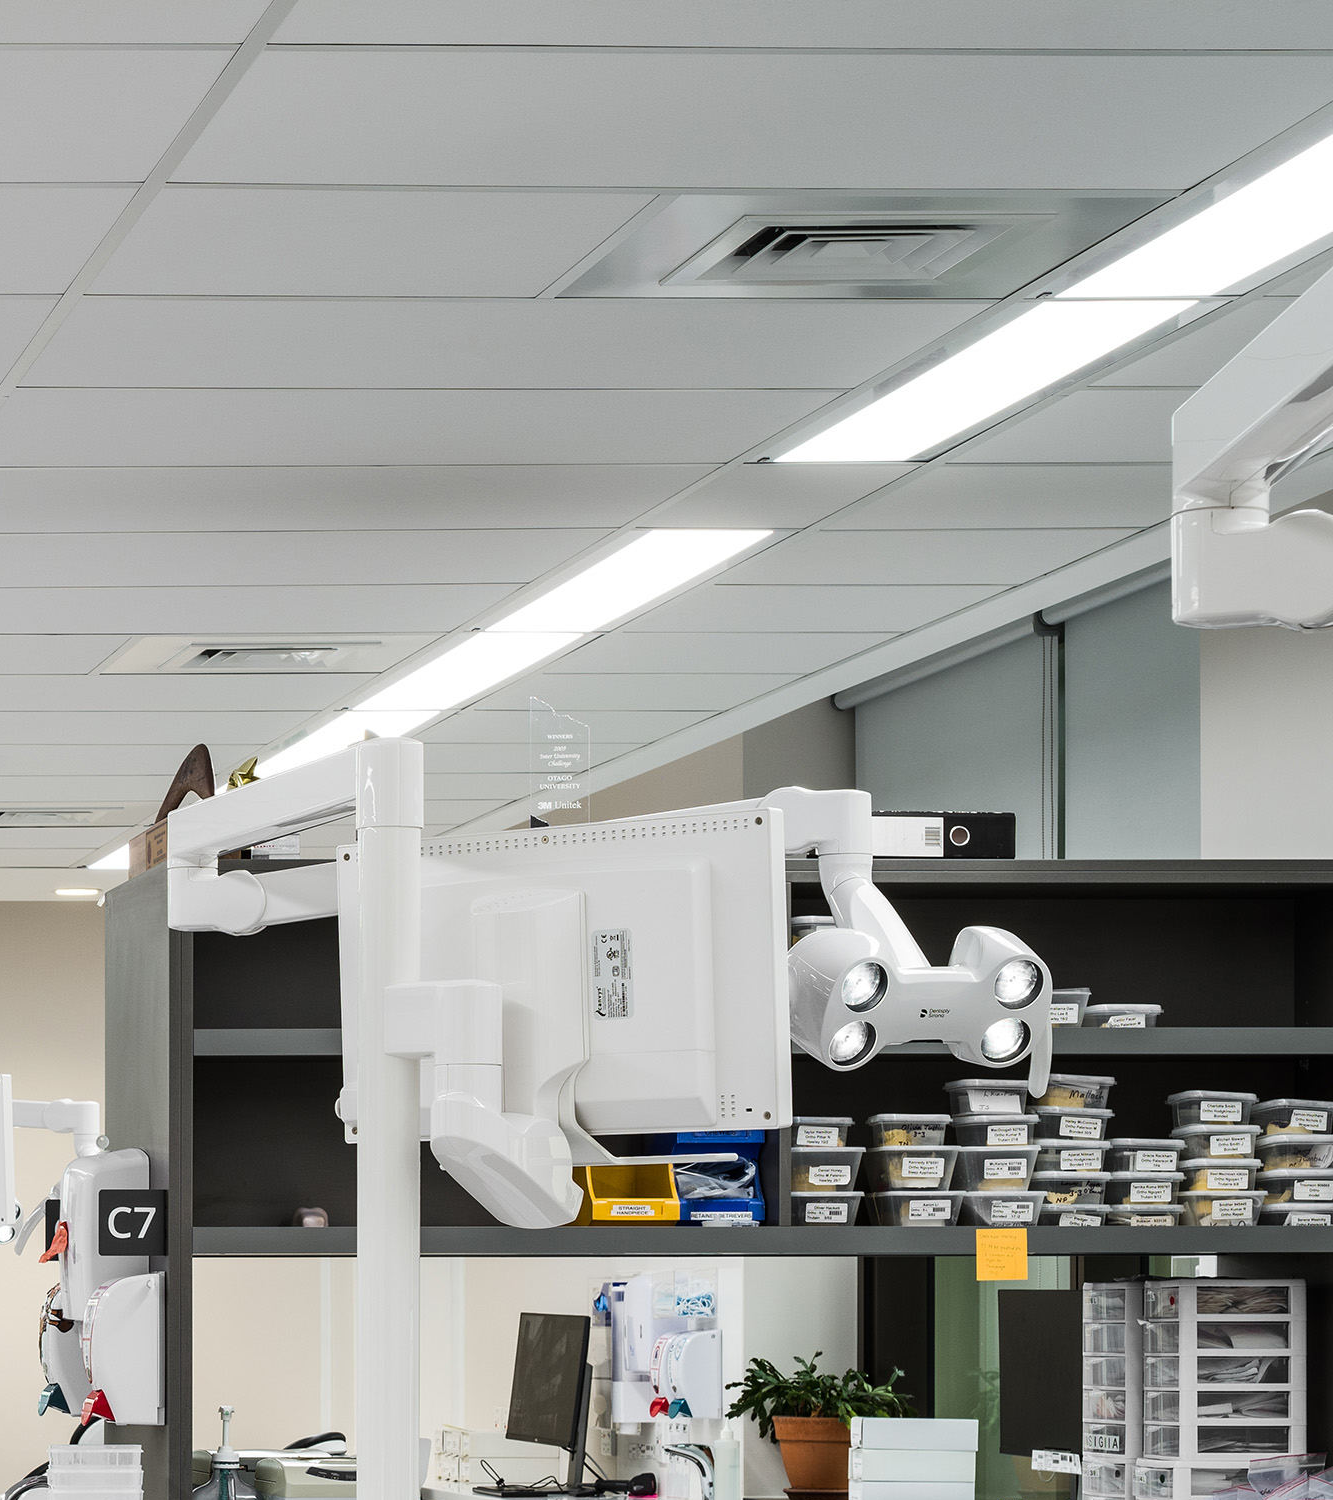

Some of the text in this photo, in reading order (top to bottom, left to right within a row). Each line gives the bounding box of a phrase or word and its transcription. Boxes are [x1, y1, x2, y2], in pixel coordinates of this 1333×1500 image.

[547, 760, 572, 768] Challenge
[537, 801, 582, 810] 3M Unitek
[1069, 1090, 1105, 1101] Malloch
[107, 1206, 157, 1239] C7
